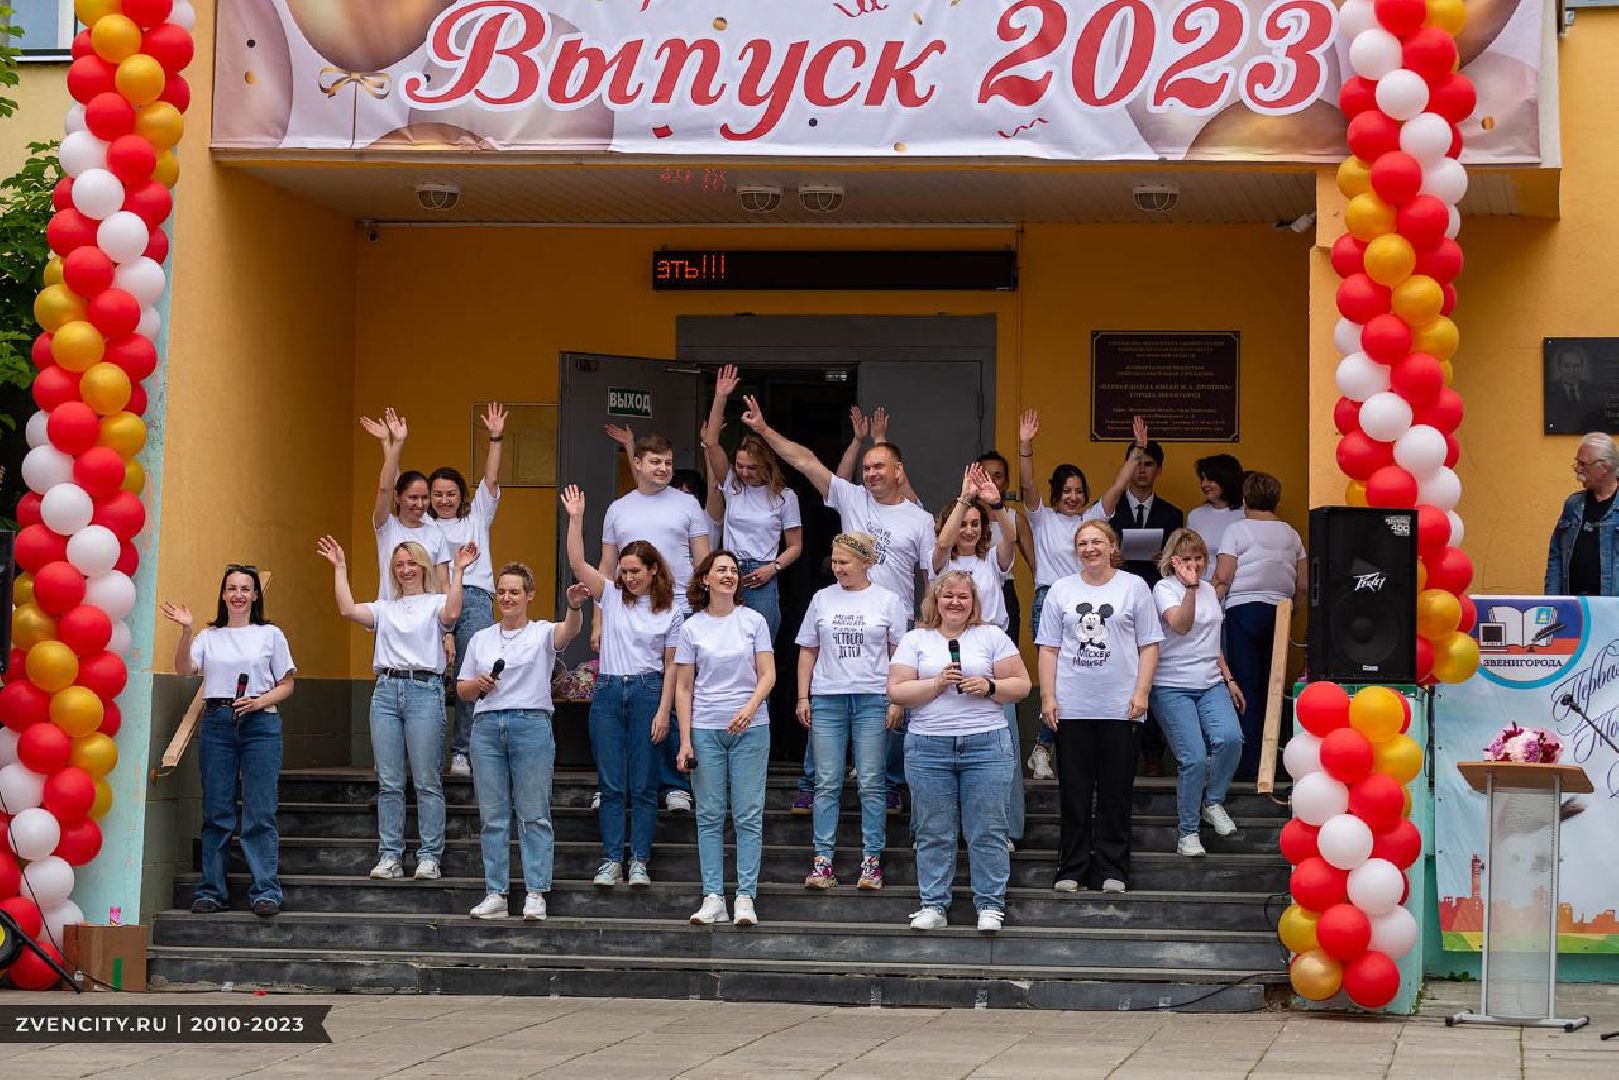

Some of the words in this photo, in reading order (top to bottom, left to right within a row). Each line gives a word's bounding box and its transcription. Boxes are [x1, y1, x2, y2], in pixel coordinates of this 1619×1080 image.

[404, 0, 947, 141] Выпуск
[978, 0, 1334, 108] 2023
[609, 391, 651, 413] ВЫХОД
[832, 632, 864, 645] ЧЕТВЕРО
[839, 644, 862, 659] ДЕТЕЙ
[1483, 659, 1563, 668] ЗВЕНИГОРОДА
